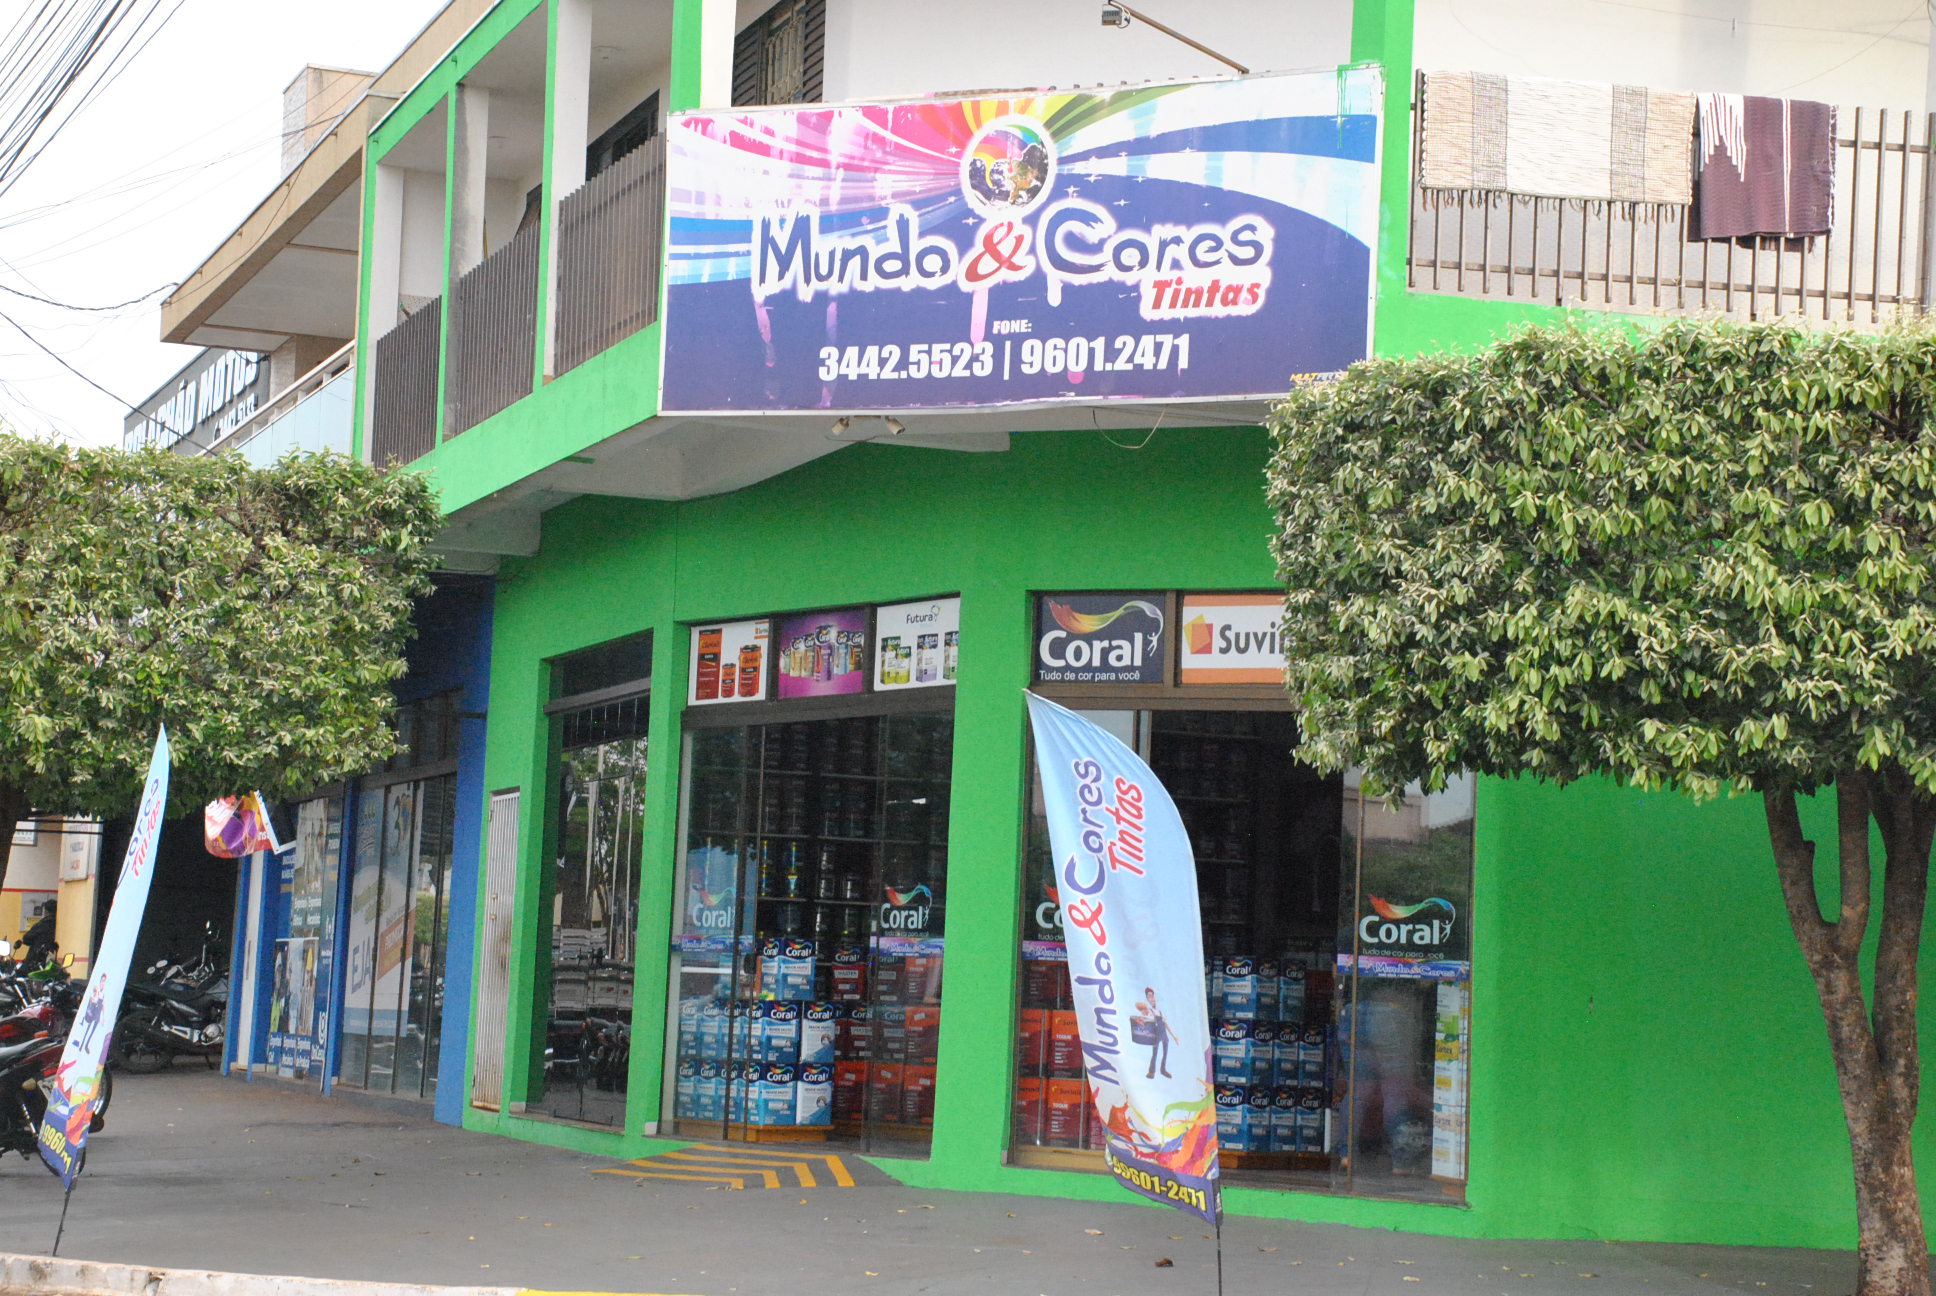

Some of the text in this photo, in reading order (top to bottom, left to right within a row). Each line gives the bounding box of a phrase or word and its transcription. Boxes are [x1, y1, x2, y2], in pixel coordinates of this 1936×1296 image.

[759, 206, 1265, 288] Mundo & Cores
[1151, 276, 1262, 310] Tintas
[992, 319, 1032, 335] FONE:
[818, 341, 994, 382] 3442.5523
[1020, 333, 1190, 375] 9601.2471
[905, 611, 934, 625] Futura
[1039, 629, 1142, 667] Coral
[1039, 669, 1140, 682] Tudo de cor para você
[1105, 777, 1144, 875] Tintas
[692, 902, 732, 928] Coral
[880, 902, 923, 929] Coral
[1064, 759, 1121, 1086] Mundo & Cores
[1358, 915, 1440, 945] Coral
[785, 946, 809, 957] Coral
[835, 953, 857, 963] Coral
[1225, 965, 1248, 975] Coral
[771, 1009, 793, 1019] Coral
[807, 1010, 830, 1020] Coral
[1220, 1028, 1242, 1038] Coral
[767, 1071, 789, 1081] Coral
[802, 1072, 826, 1082] Coral
[1217, 1093, 1239, 1104] Coral
[1112, 1155, 1207, 1211] 99601-2471
